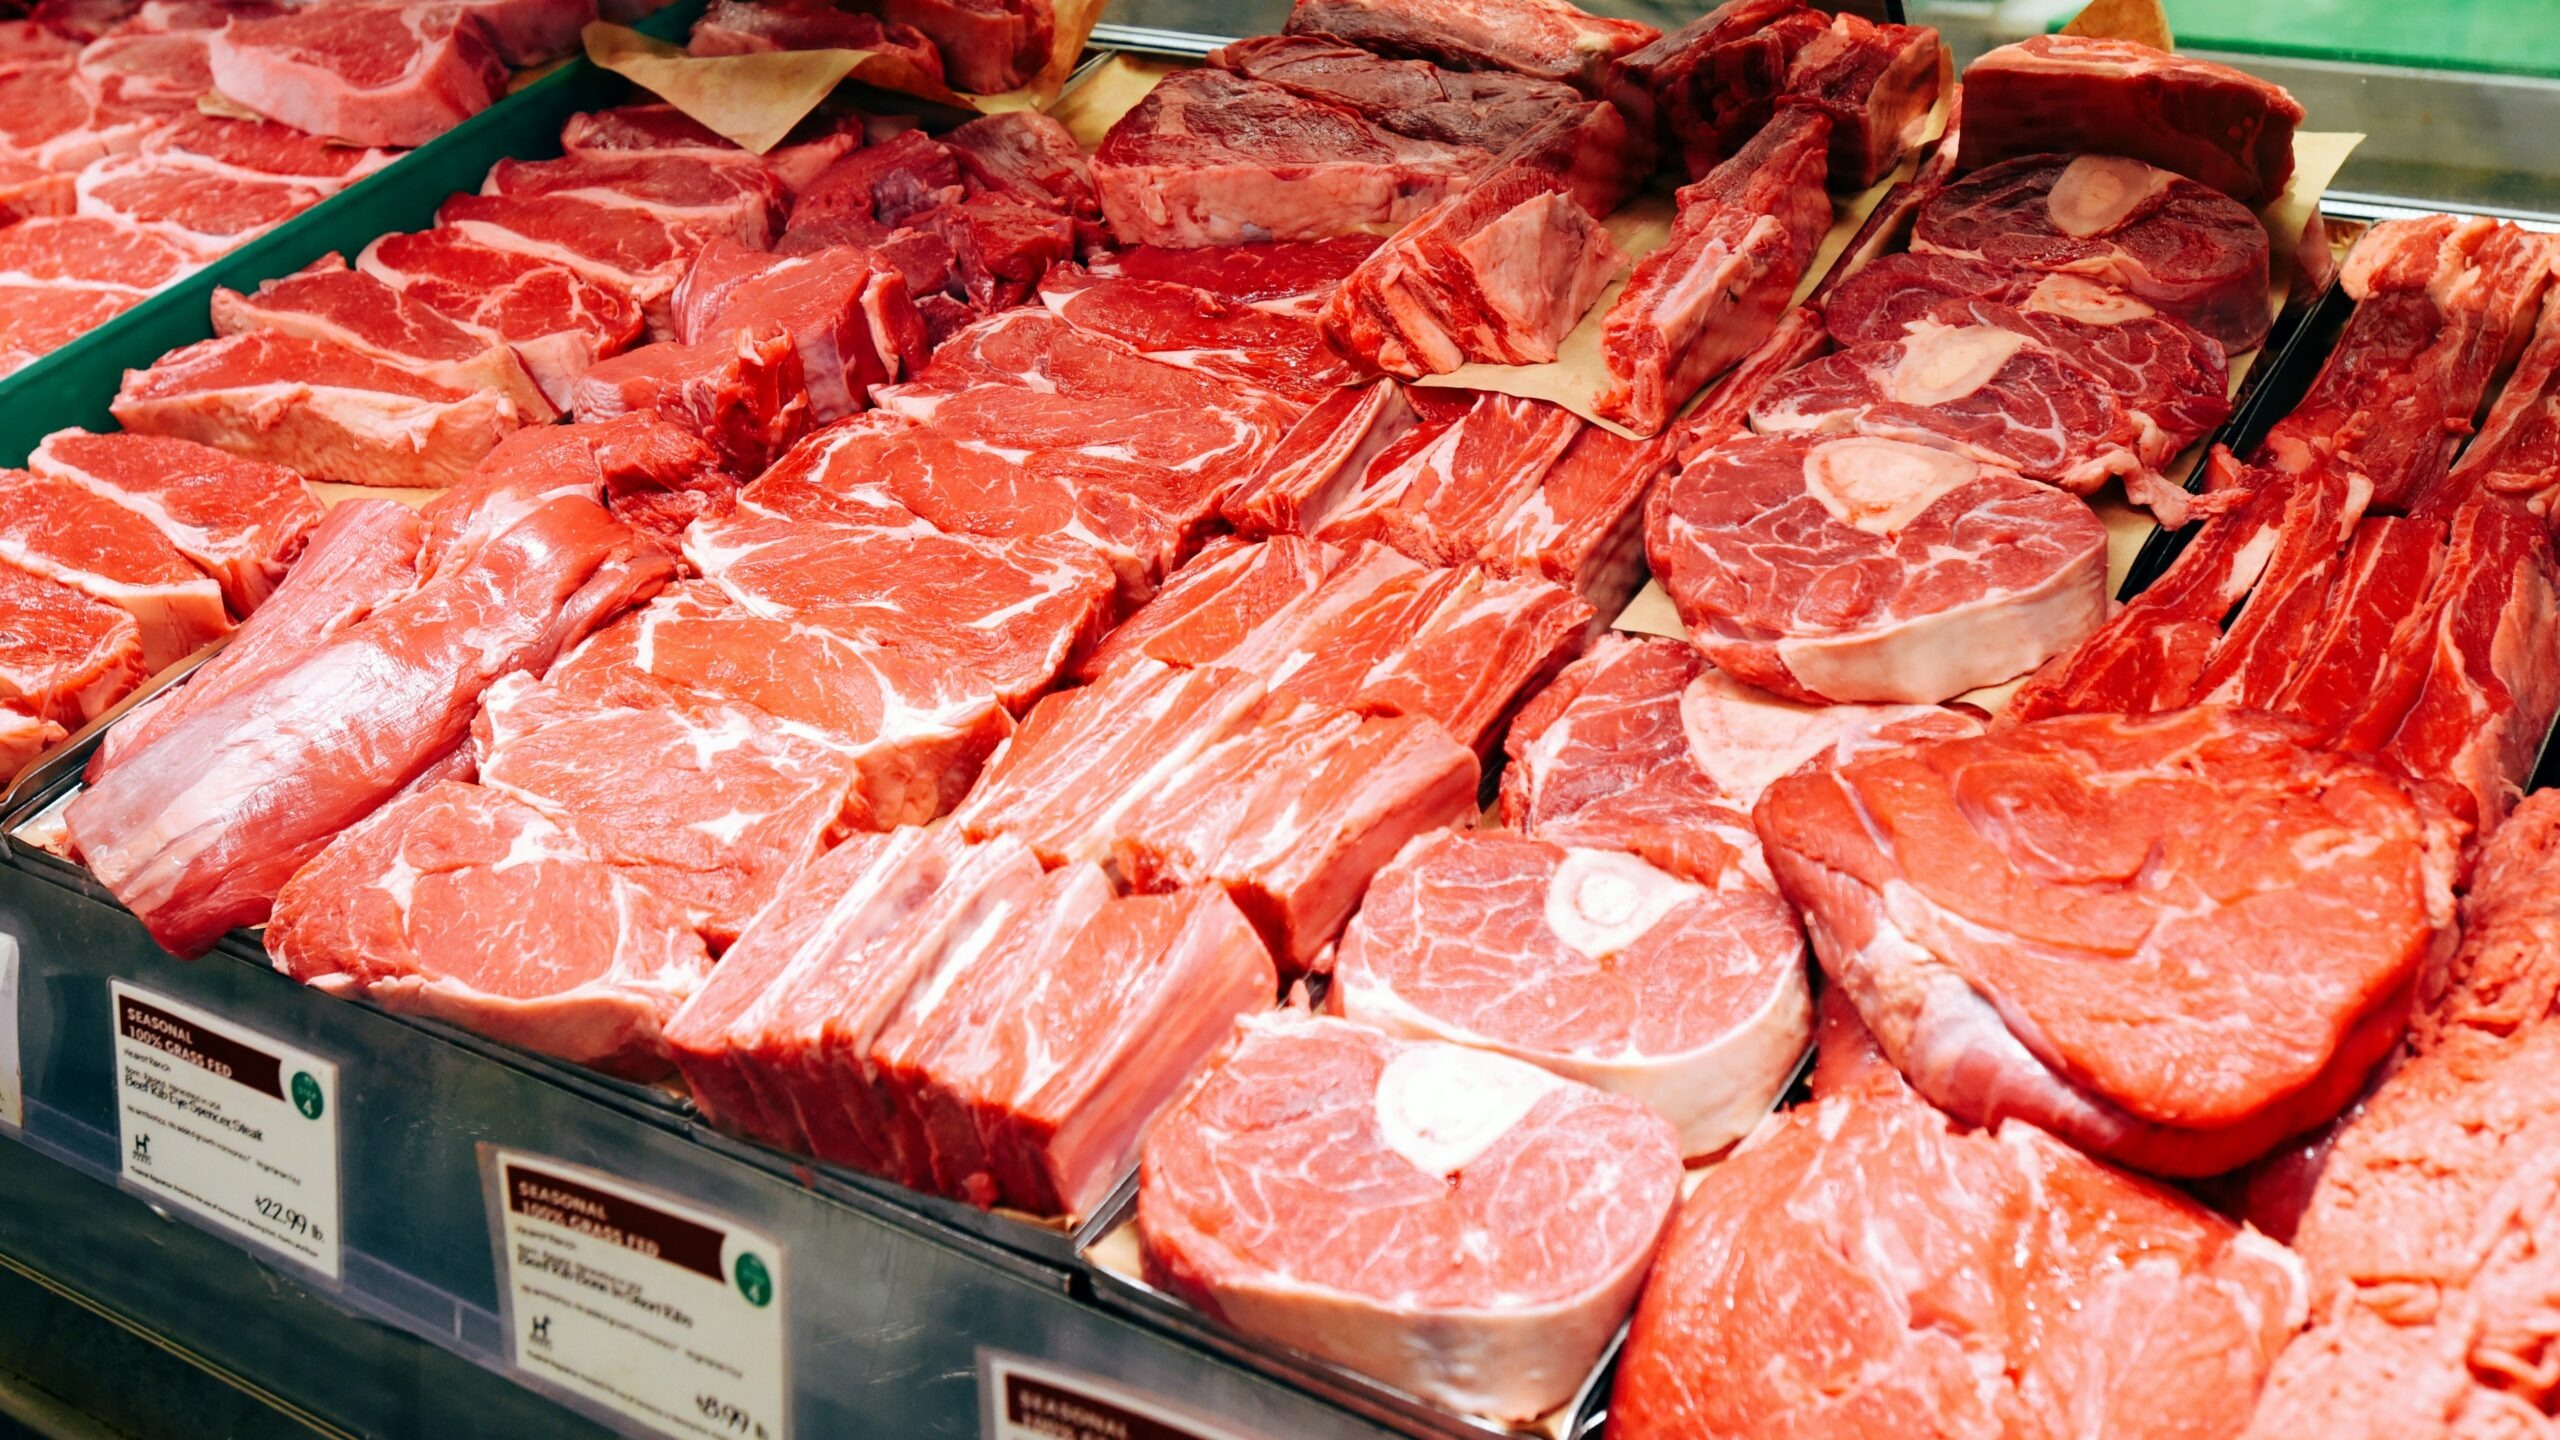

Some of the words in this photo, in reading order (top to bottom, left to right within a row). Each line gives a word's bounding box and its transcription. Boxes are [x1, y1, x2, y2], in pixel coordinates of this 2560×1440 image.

[127, 1007, 193, 1045] SEASONAL
[129, 1025, 163, 1049] 100%
[165, 1040, 205, 1067] GRASS
[207, 1058, 232, 1078] FED
[519, 1181, 608, 1221] SEASONAL
[568, 1215, 624, 1246] GRASS
[626, 1233, 660, 1258] FED
